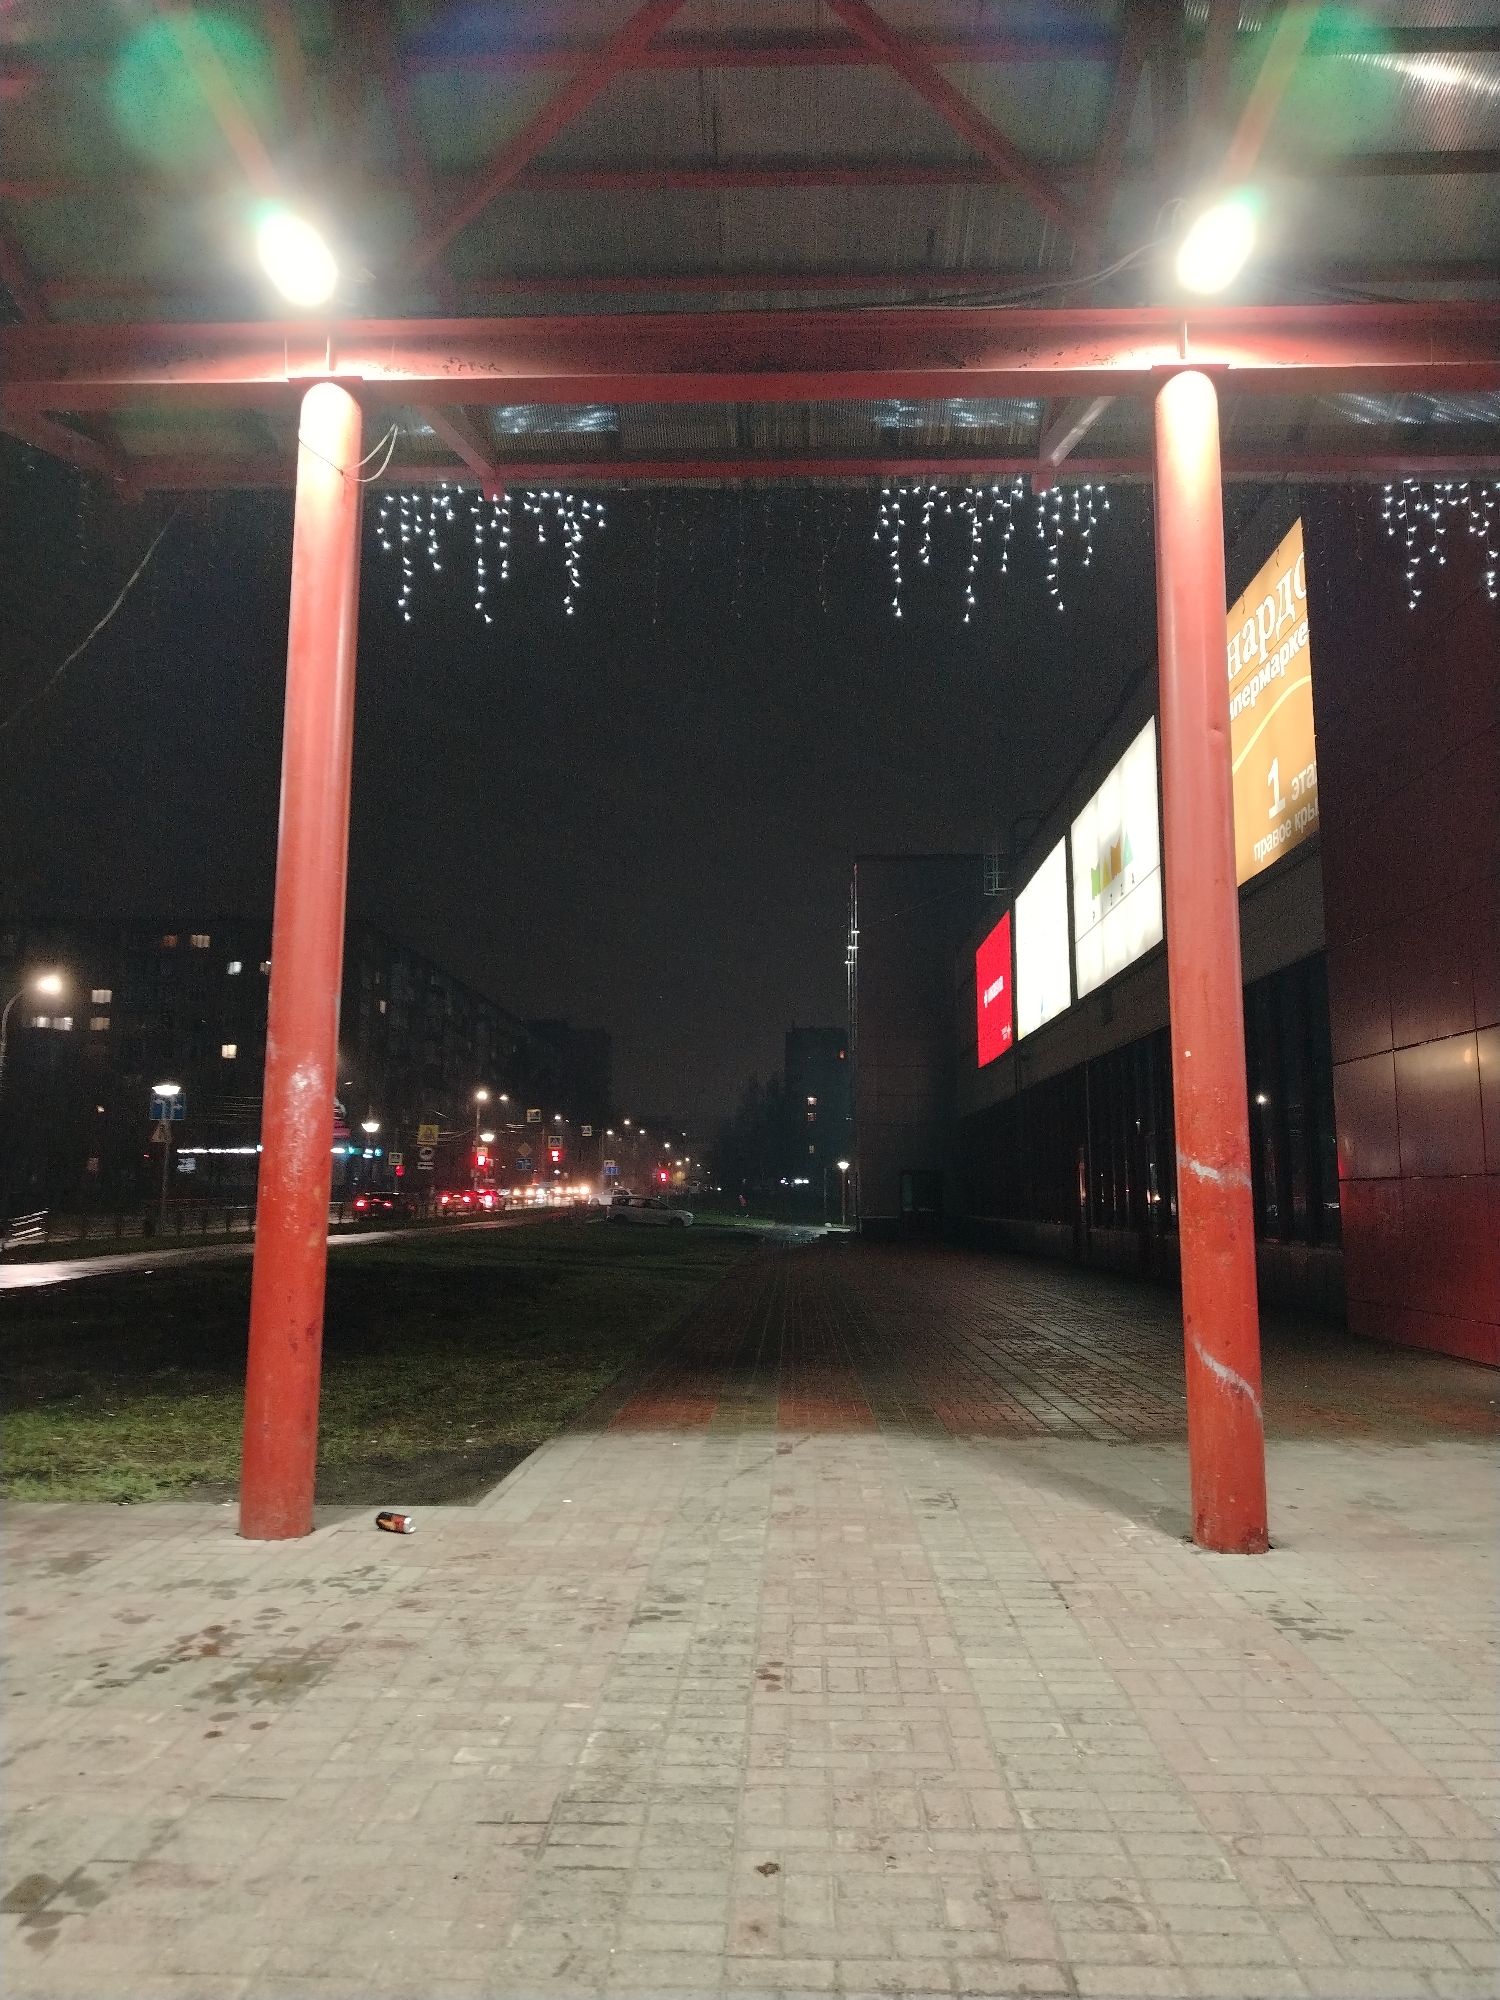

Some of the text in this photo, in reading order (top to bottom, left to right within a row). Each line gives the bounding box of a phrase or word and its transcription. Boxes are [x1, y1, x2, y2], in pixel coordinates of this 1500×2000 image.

[1267, 756, 1318, 820] 1 эта
[1253, 797, 1319, 862] правое кры
